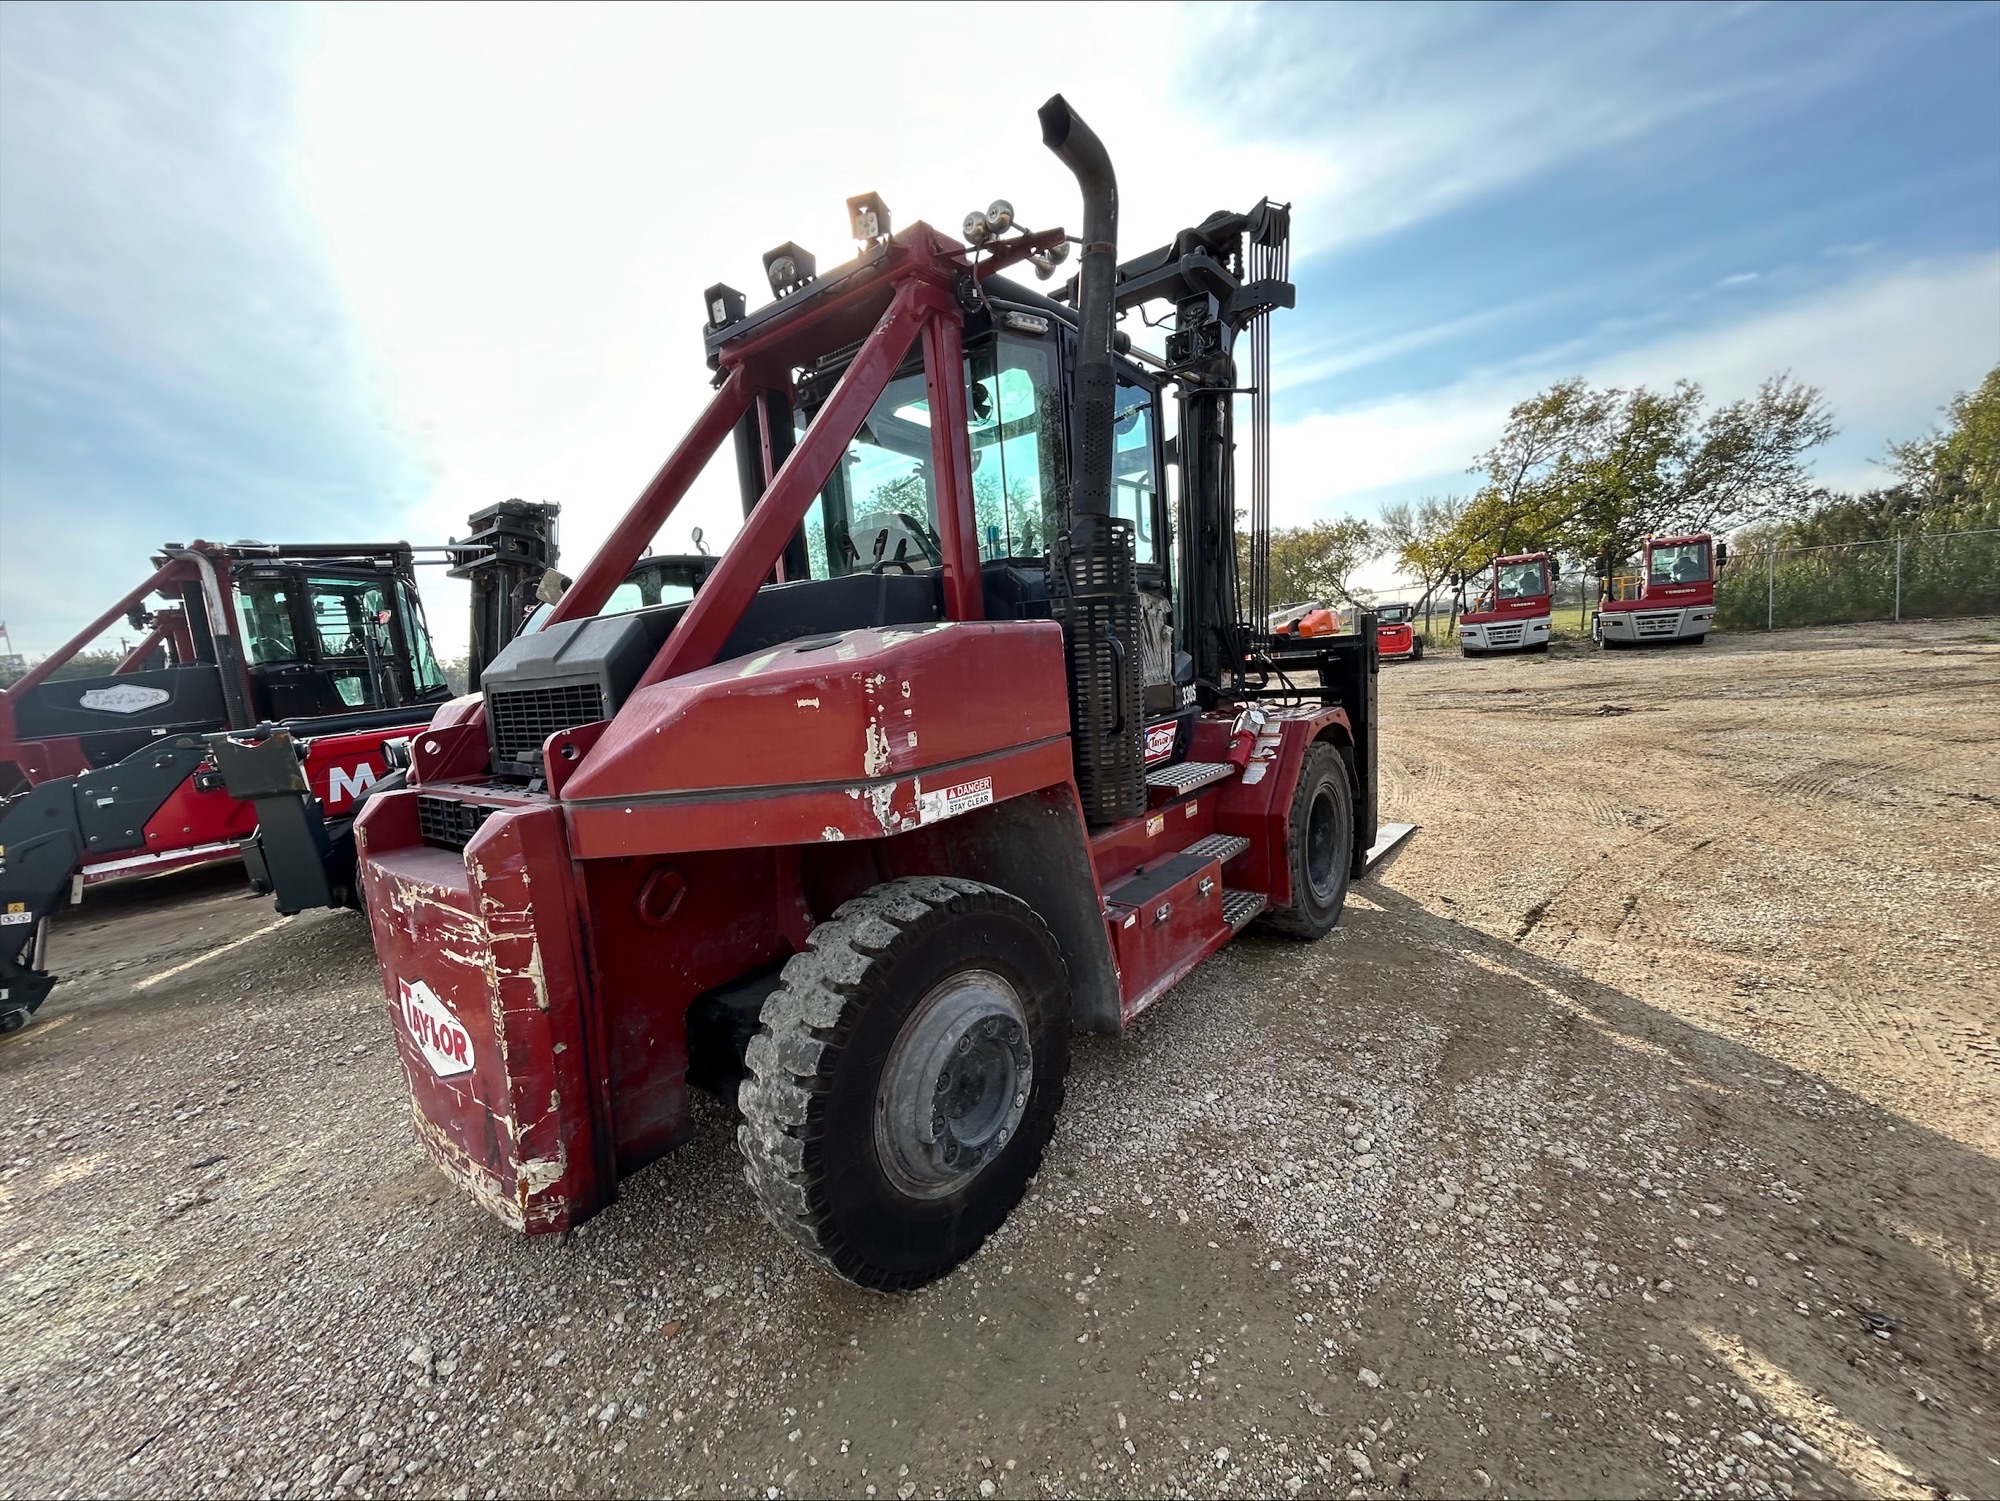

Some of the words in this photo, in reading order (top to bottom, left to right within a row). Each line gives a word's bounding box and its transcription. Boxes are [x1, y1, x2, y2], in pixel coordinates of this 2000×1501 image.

[88, 691, 162, 706] TAYLOR
[1151, 736, 1168, 748] TAYLOR
[957, 779, 990, 795] DANGER
[949, 803, 965, 813] STAY
[967, 795, 989, 808] CLEAR
[400, 980, 468, 1066] TAYLOR
